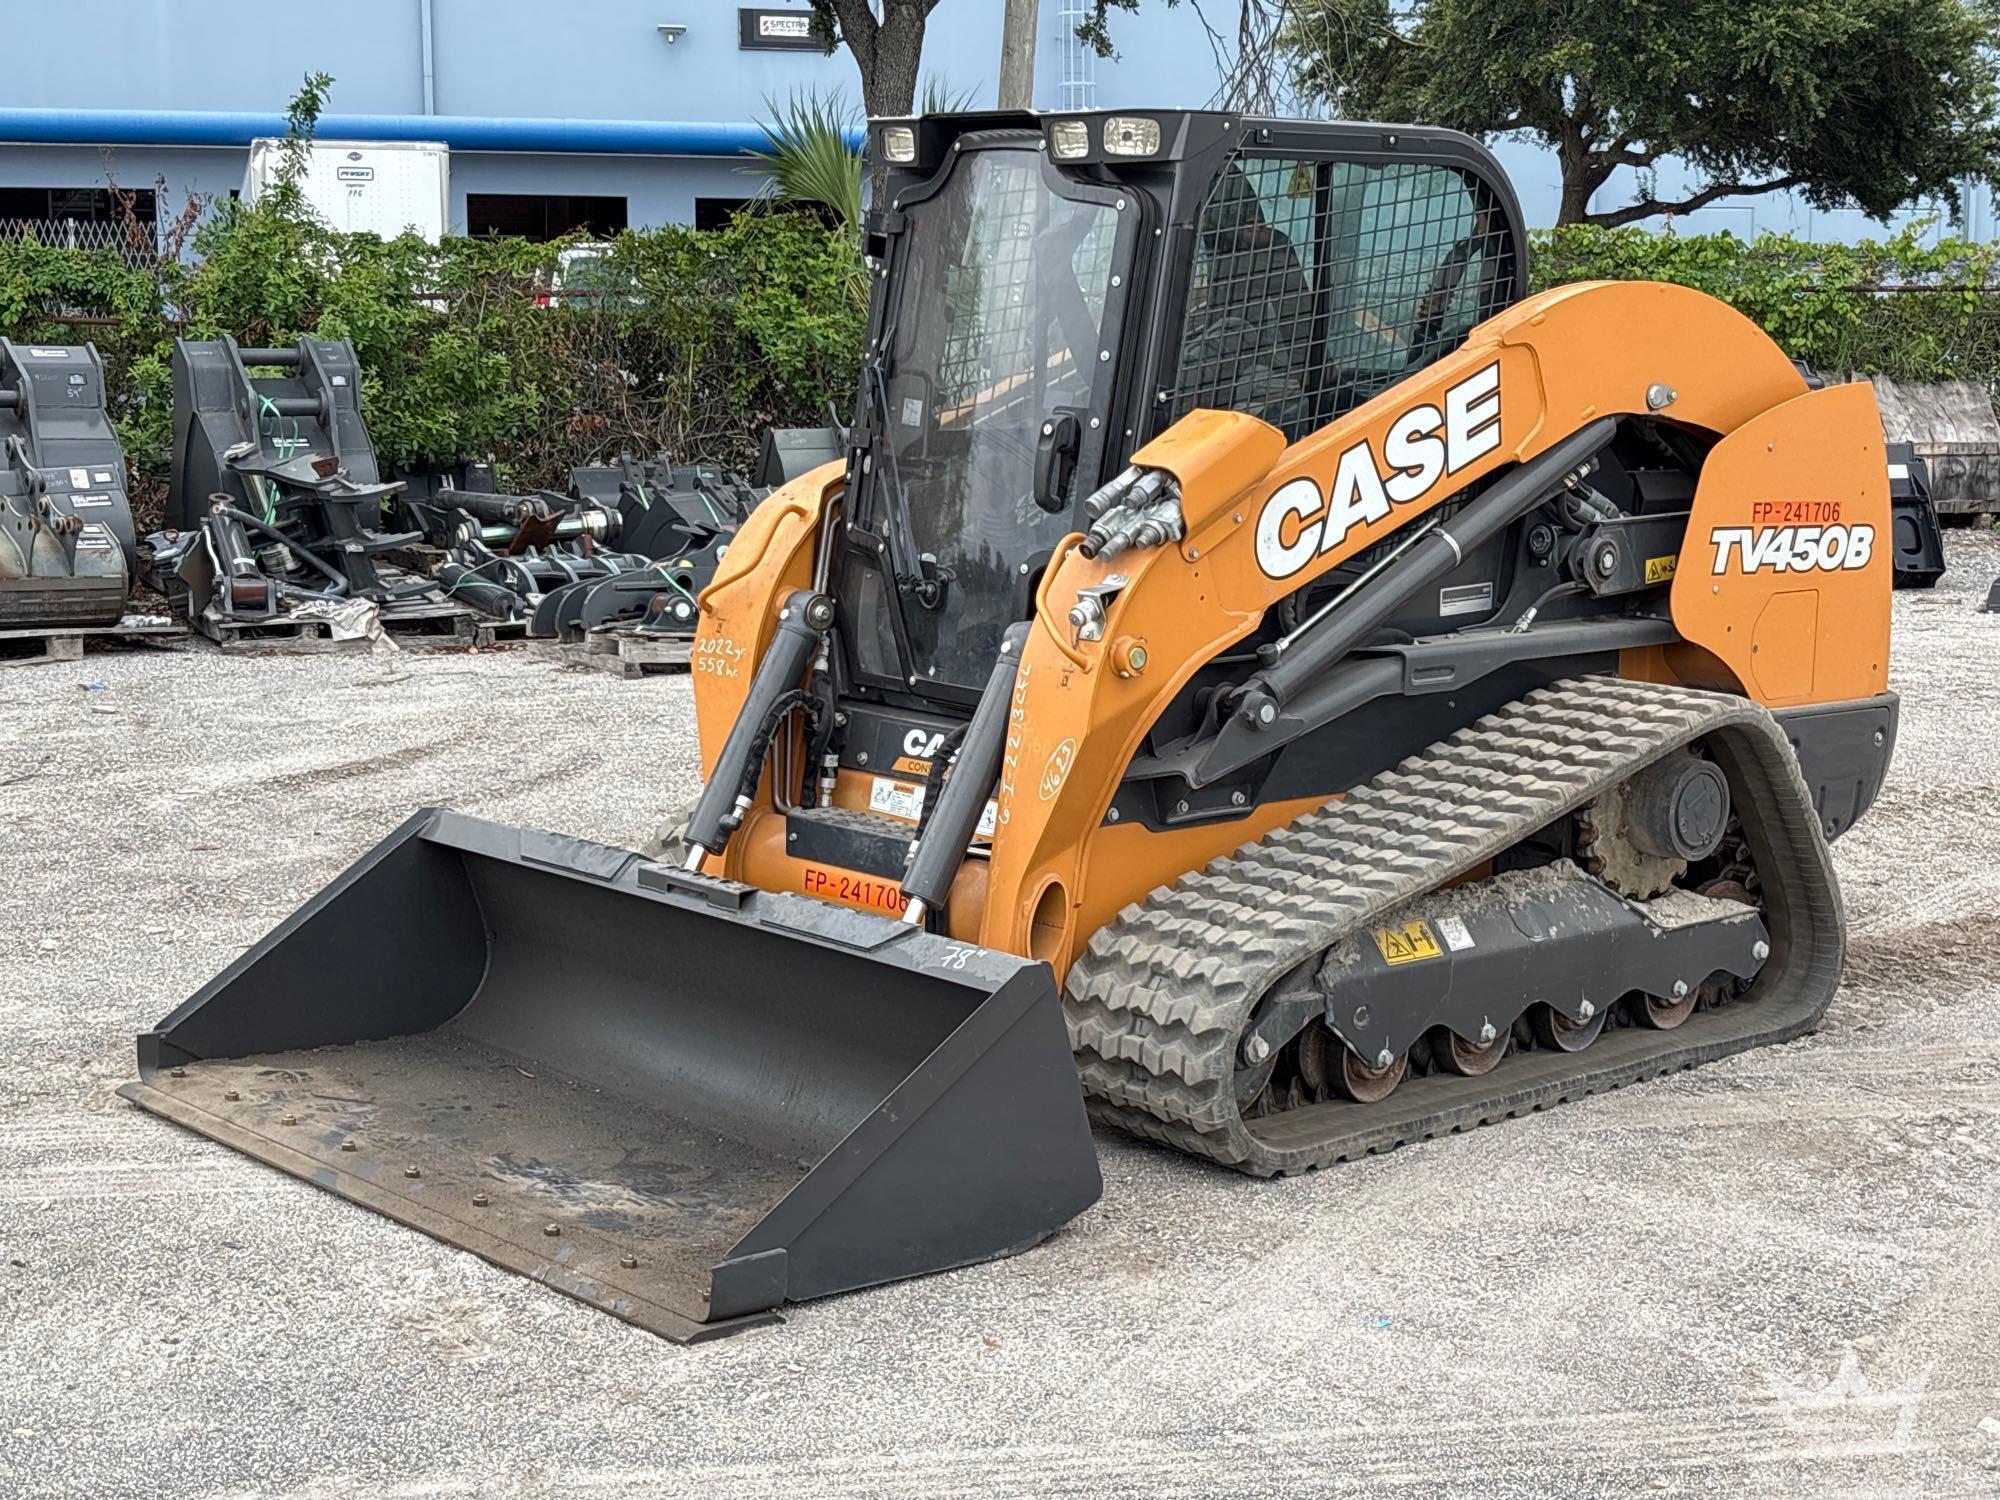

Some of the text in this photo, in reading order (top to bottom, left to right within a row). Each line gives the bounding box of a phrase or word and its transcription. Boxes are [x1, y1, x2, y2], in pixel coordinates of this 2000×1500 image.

[770, 20, 806, 28] SPECTRA
[1254, 359, 1502, 581] CASE
[1752, 502, 1840, 522] FP-241706
[1709, 523, 1876, 576] TV450B
[941, 946, 988, 970] 78"
